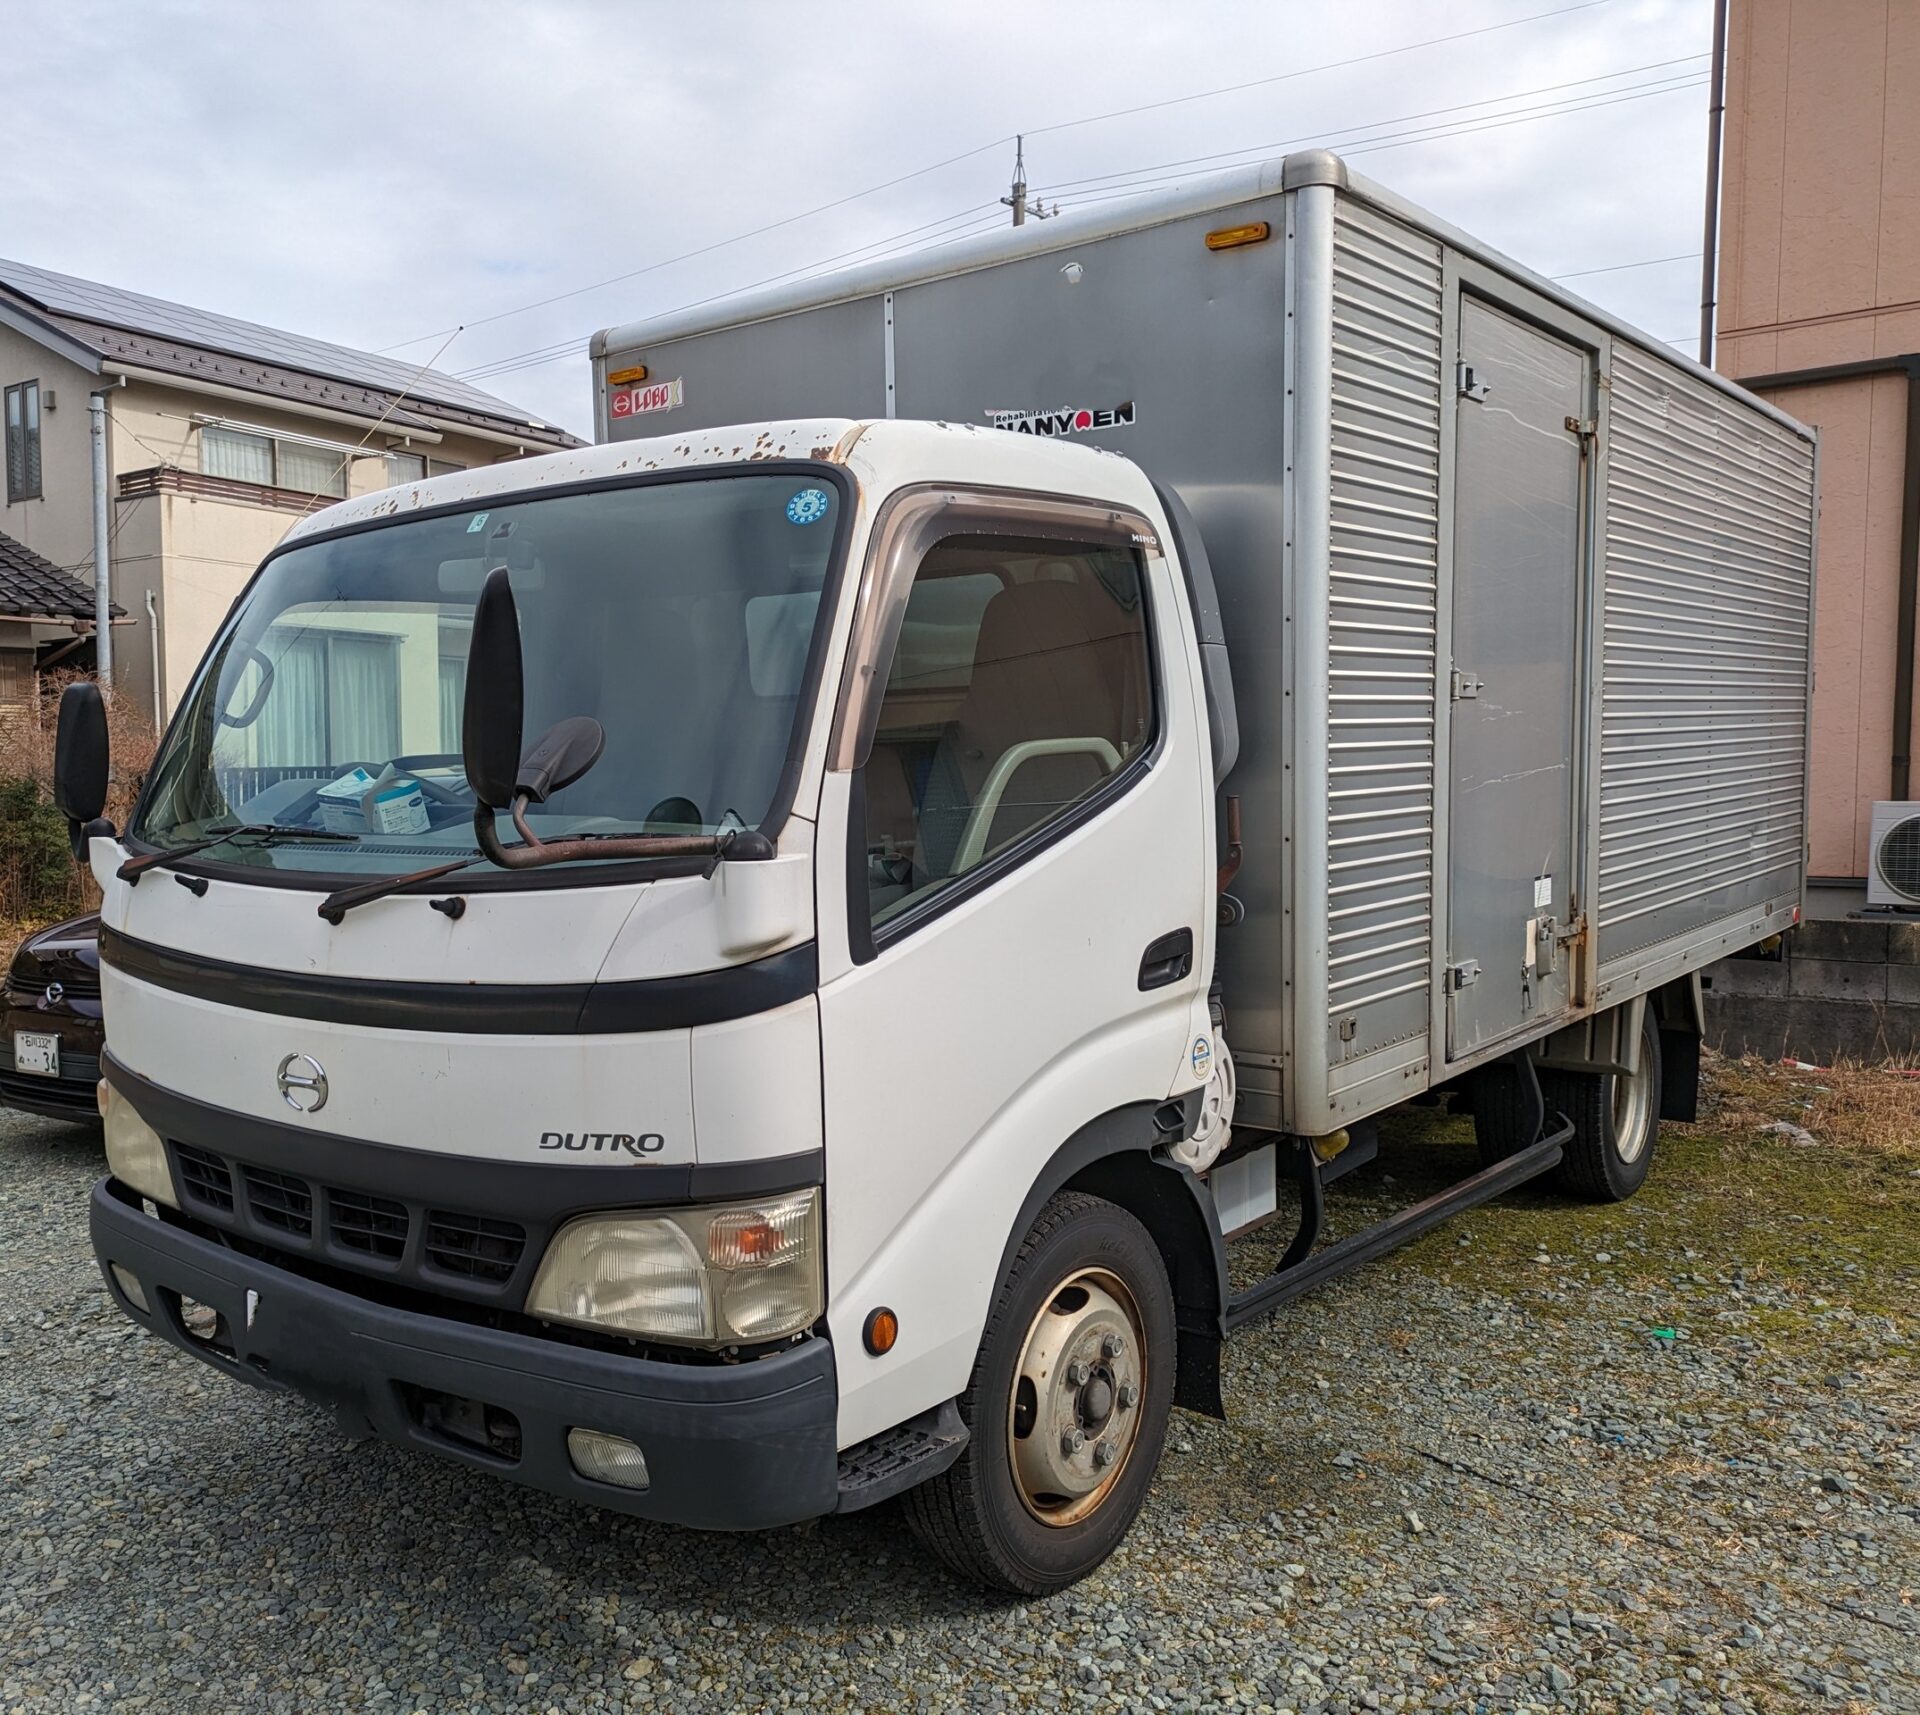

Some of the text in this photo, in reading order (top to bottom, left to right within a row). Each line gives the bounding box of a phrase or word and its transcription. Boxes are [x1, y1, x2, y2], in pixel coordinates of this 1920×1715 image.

[801, 502, 812, 513] 5
[1132, 534, 1157, 545] HINO
[539, 1132, 665, 1158] DUTRO
